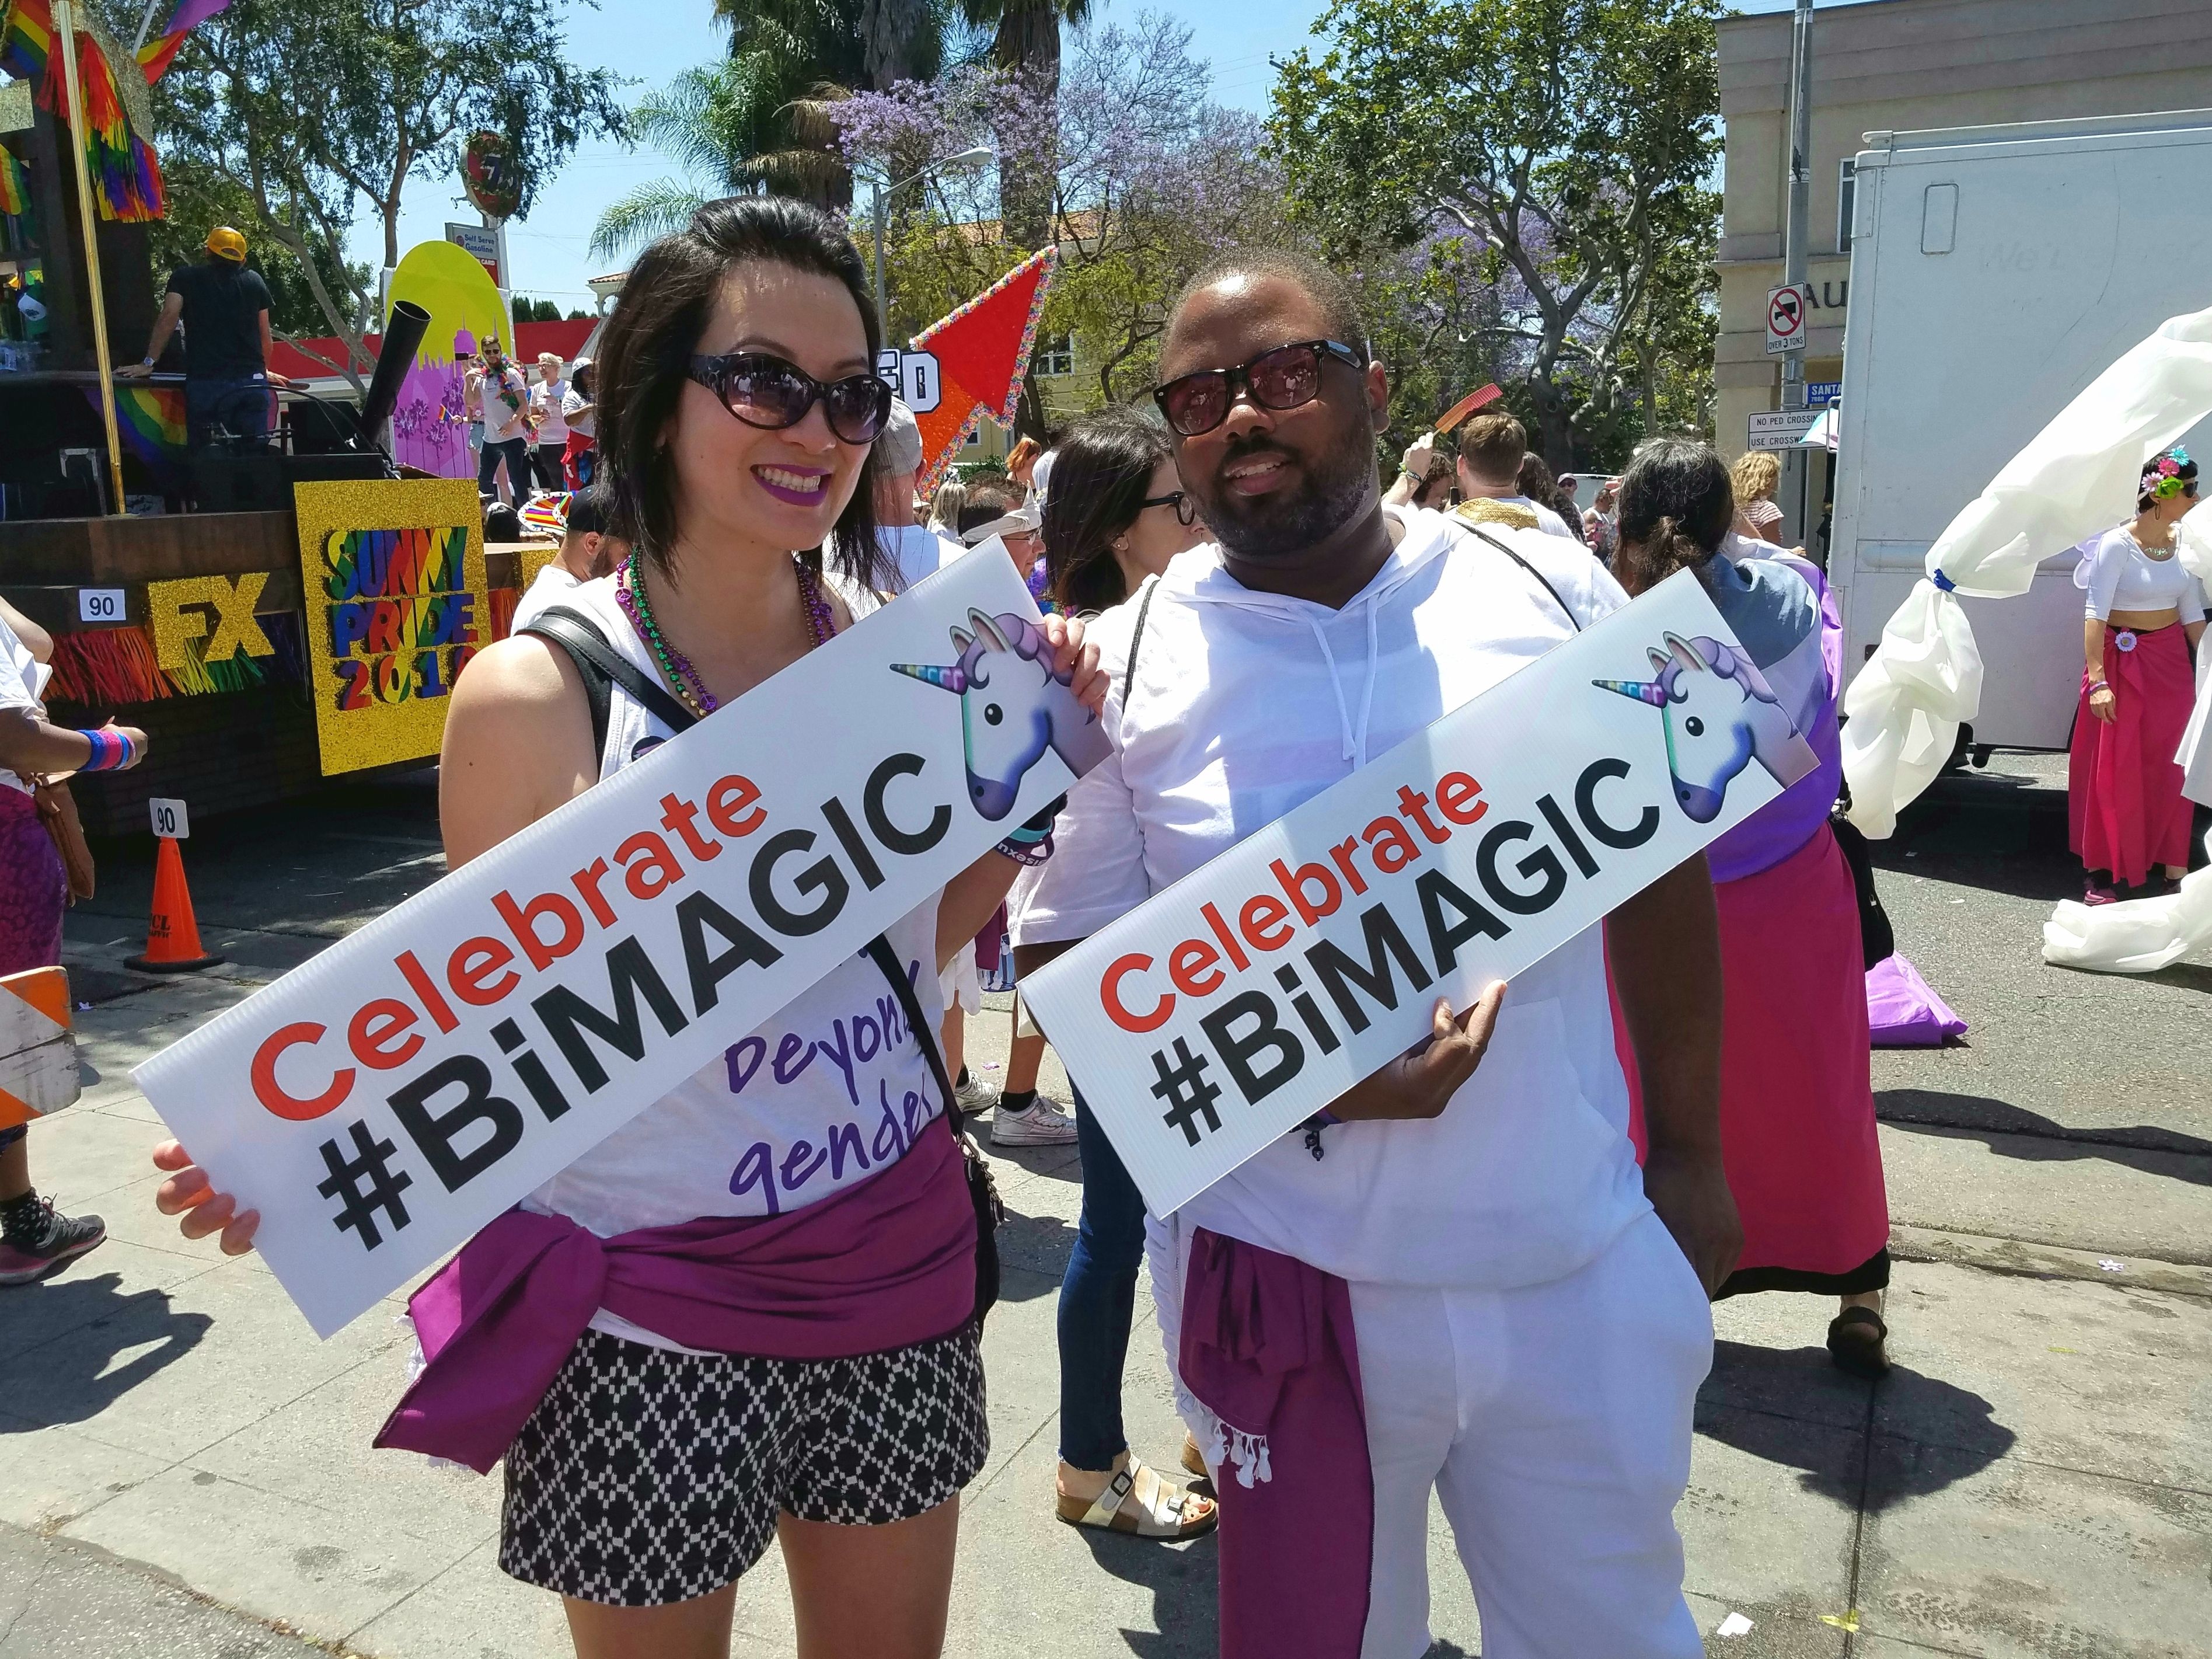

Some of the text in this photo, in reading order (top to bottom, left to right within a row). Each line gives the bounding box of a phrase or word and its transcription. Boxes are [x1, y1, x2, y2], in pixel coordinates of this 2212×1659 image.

[466, 243, 493, 253] Gasoline
[477, 236, 494, 245] Serve
[1768, 336, 1804, 350] OVER 3 TONS
[1811, 384, 1842, 395] SANTA
[1756, 415, 1819, 426] NO PED CROSSIN
[1751, 438, 1766, 447] USE
[325, 527, 467, 601] SUNNY
[89, 597, 114, 616] 90
[148, 572, 275, 670] FX
[327, 594, 479, 658] PRIDE
[157, 807, 176, 834] 90
[997, 842, 1049, 866] Bisexu
[1100, 771, 1489, 1033] Celebrate
[250, 775, 768, 1123] Celebrate
[1150, 758, 1660, 1148] #BiMAGIC
[316, 752, 952, 1252] #BiMAGIC
